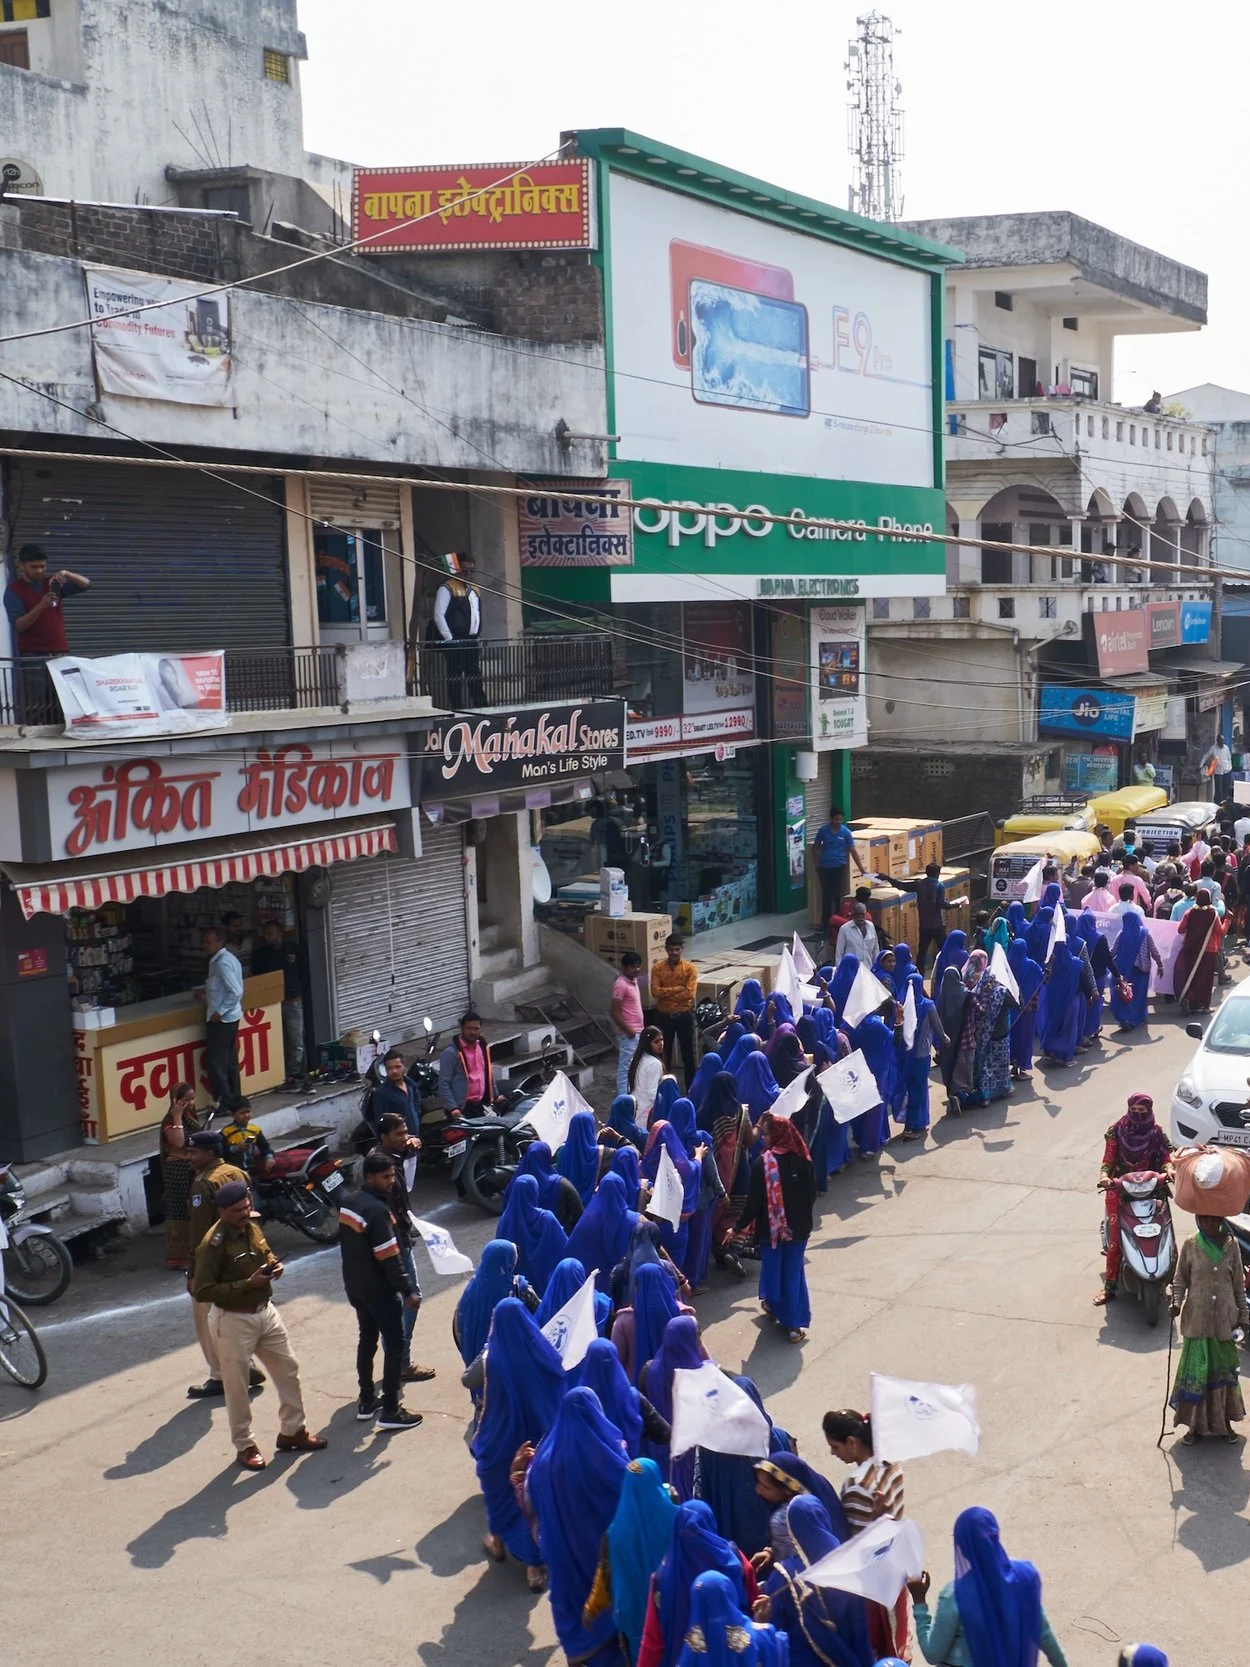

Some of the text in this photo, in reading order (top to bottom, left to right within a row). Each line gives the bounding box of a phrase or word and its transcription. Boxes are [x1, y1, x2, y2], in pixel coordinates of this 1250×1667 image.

[363, 190, 433, 221] बापना
[144, 323, 176, 339] Futures
[633, 497, 934, 547] oppo Camera Phone
[1152, 616, 1175, 633] Lenovo
[1104, 713, 1119, 721] LIFE
[579, 724, 619, 752] Stores
[626, 728, 646, 741] ED.TV
[522, 754, 608, 779] Man's Life Style
[65, 758, 221, 857] अंकित
